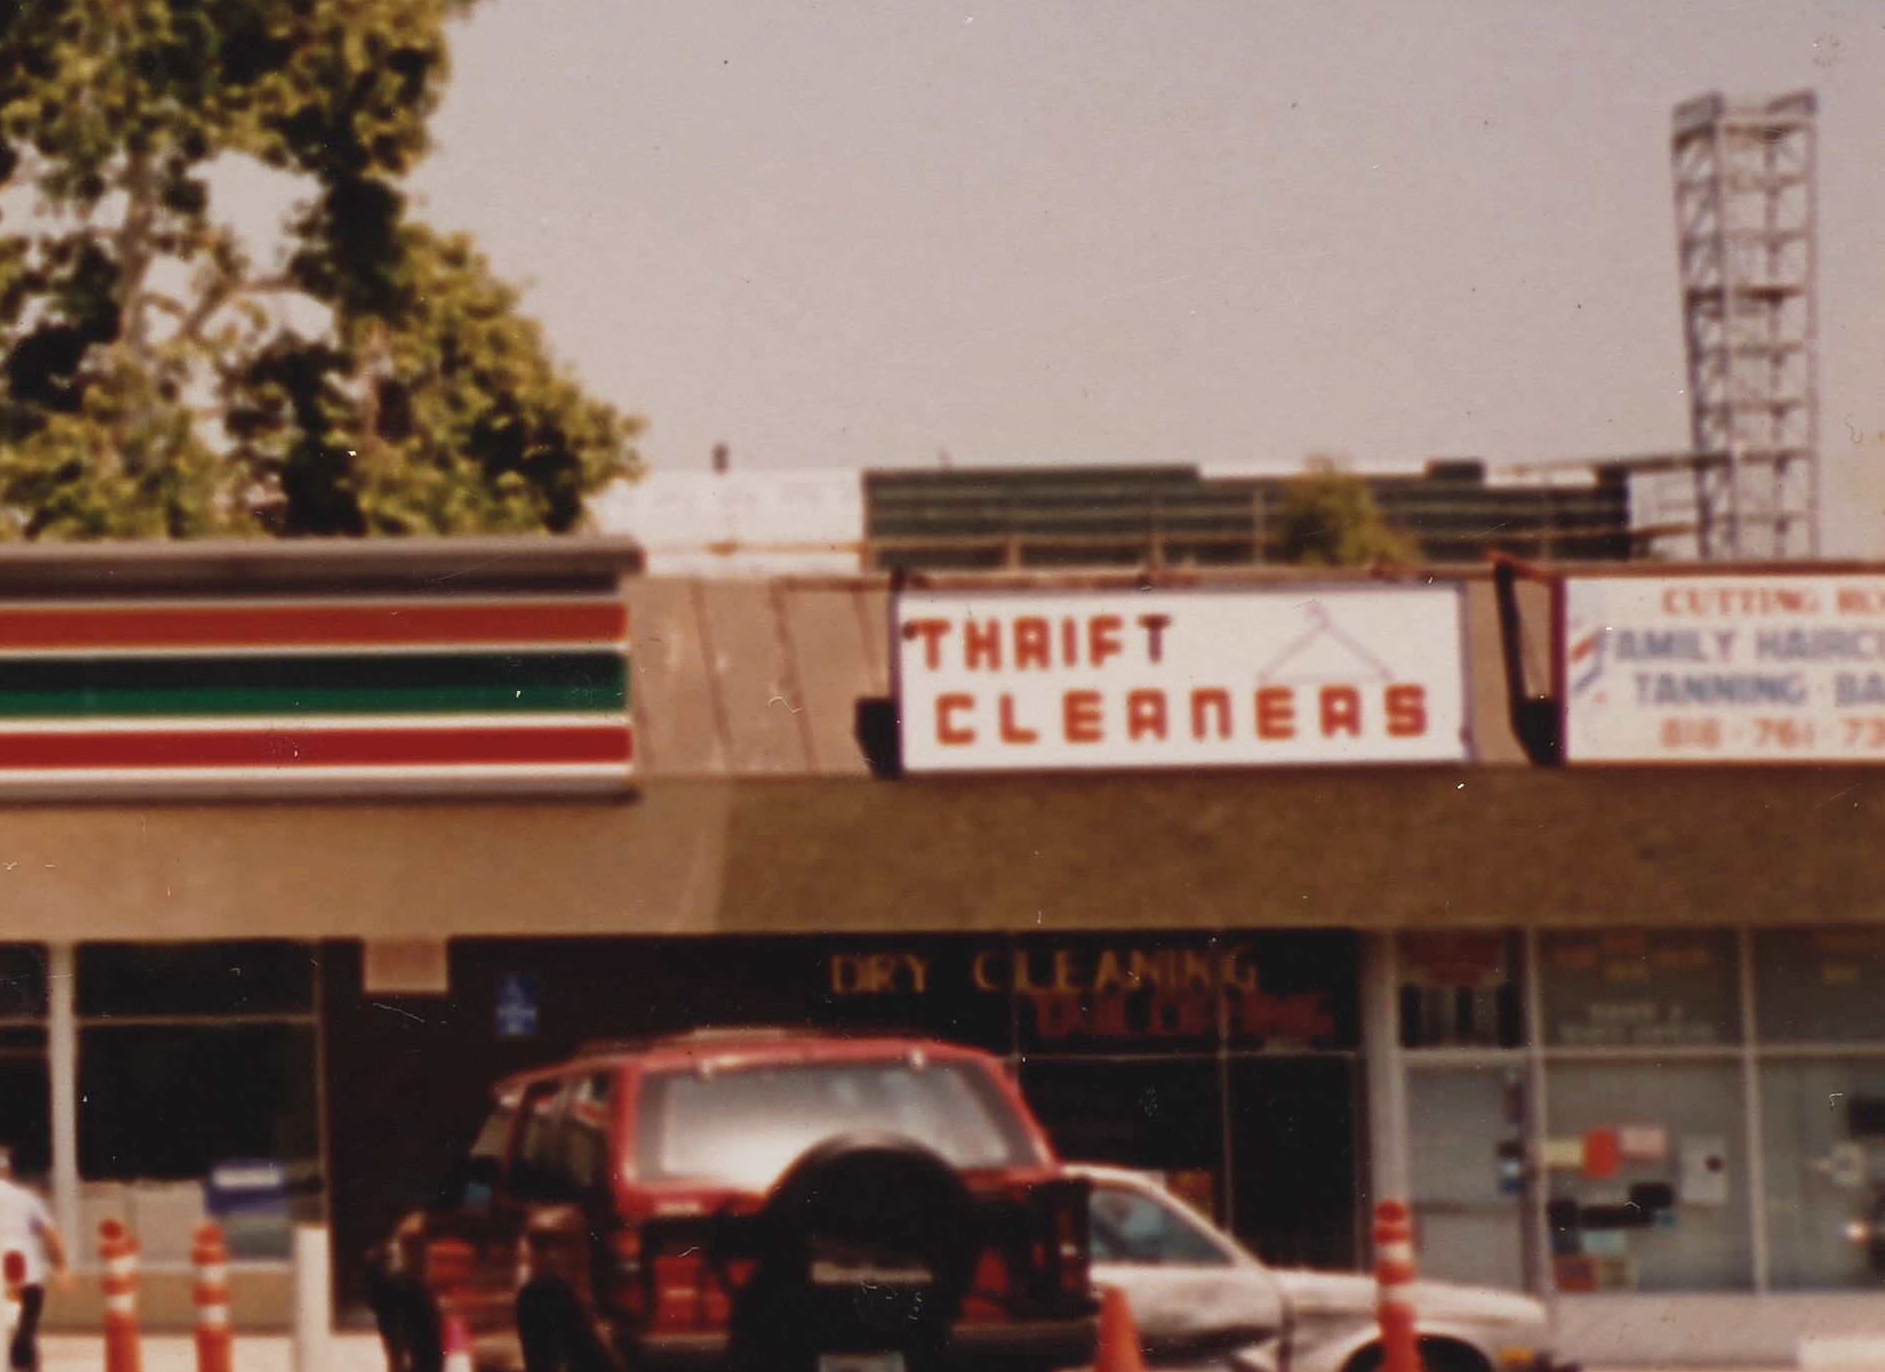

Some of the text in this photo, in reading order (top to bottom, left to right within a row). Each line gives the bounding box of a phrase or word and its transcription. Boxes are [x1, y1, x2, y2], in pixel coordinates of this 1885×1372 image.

[914, 613, 1172, 672] THRIFT
[830, 945, 1260, 996] DRY CLEANING
